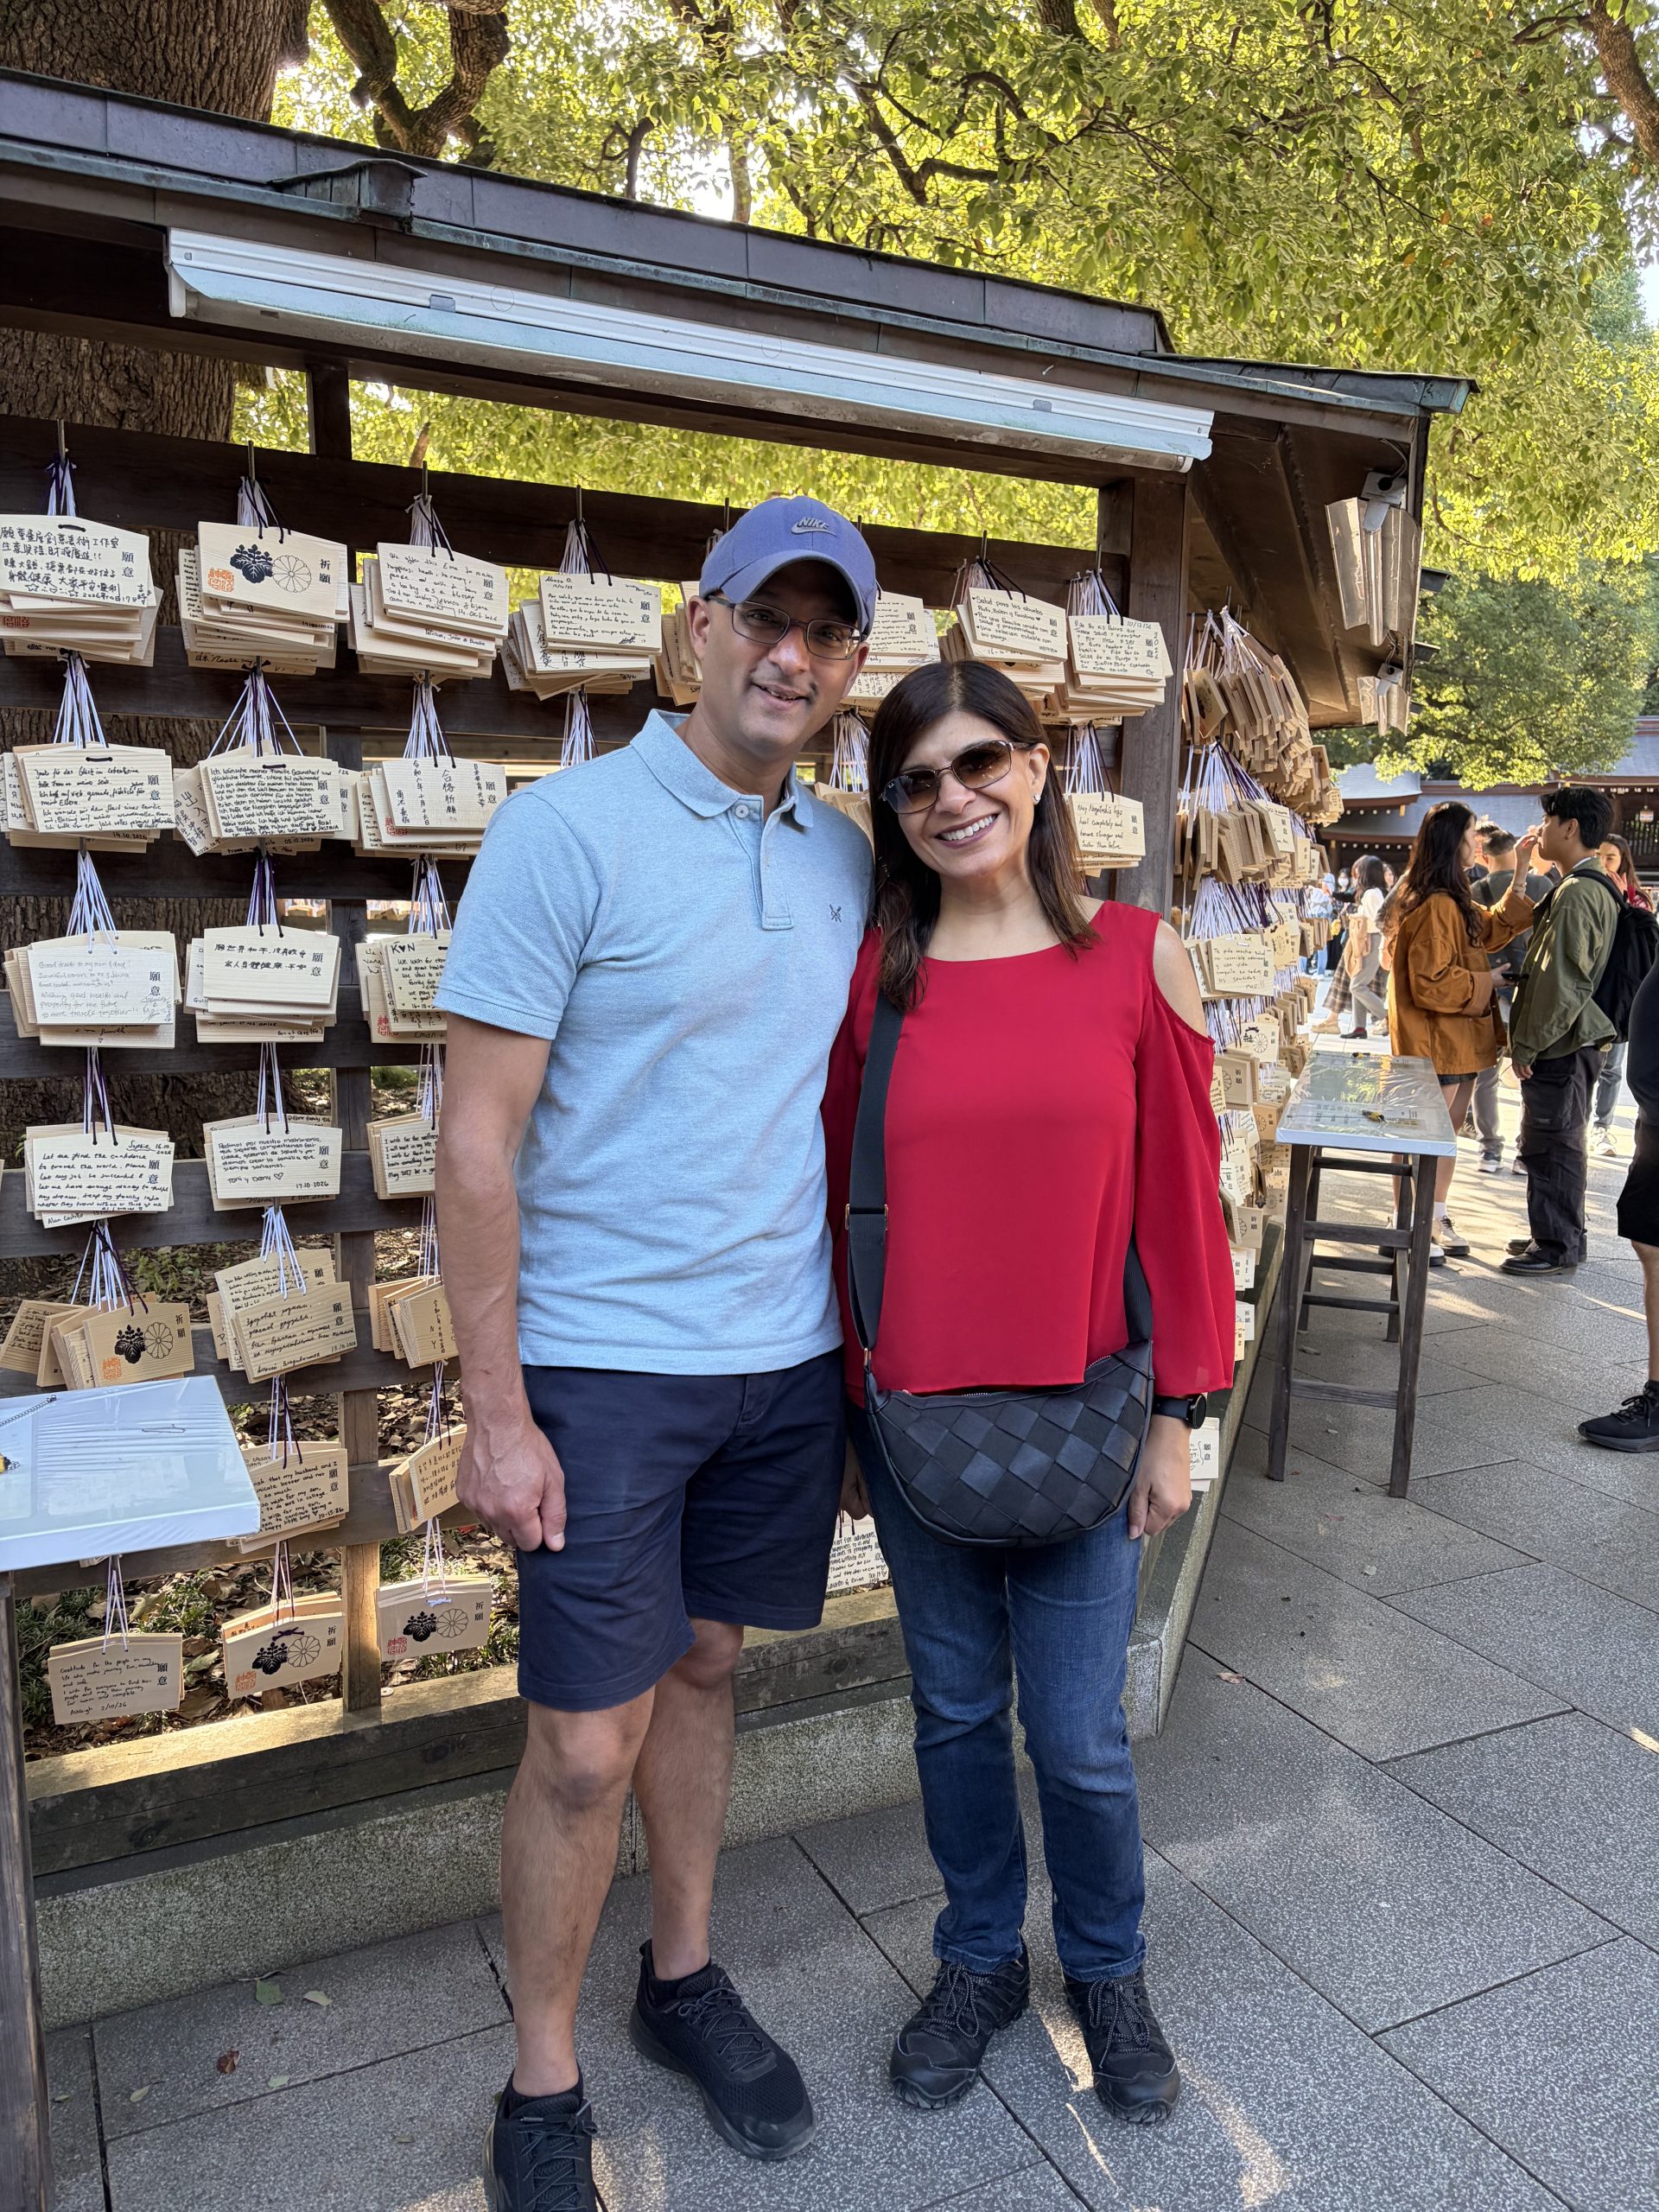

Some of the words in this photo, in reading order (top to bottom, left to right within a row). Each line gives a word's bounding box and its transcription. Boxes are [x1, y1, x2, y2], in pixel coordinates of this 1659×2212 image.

[799, 518, 830, 529] NIKE
[319, 558, 331, 584] 祈願
[976, 596, 993, 605] Salud
[1023, 607, 1043, 615] abuelos
[311, 952, 323, 976] 願意
[149, 971, 161, 996] 願意
[175, 1314, 186, 1338] 祈願
[296, 1465, 318, 1475] husband
[327, 1624, 337, 1648] 祈願
